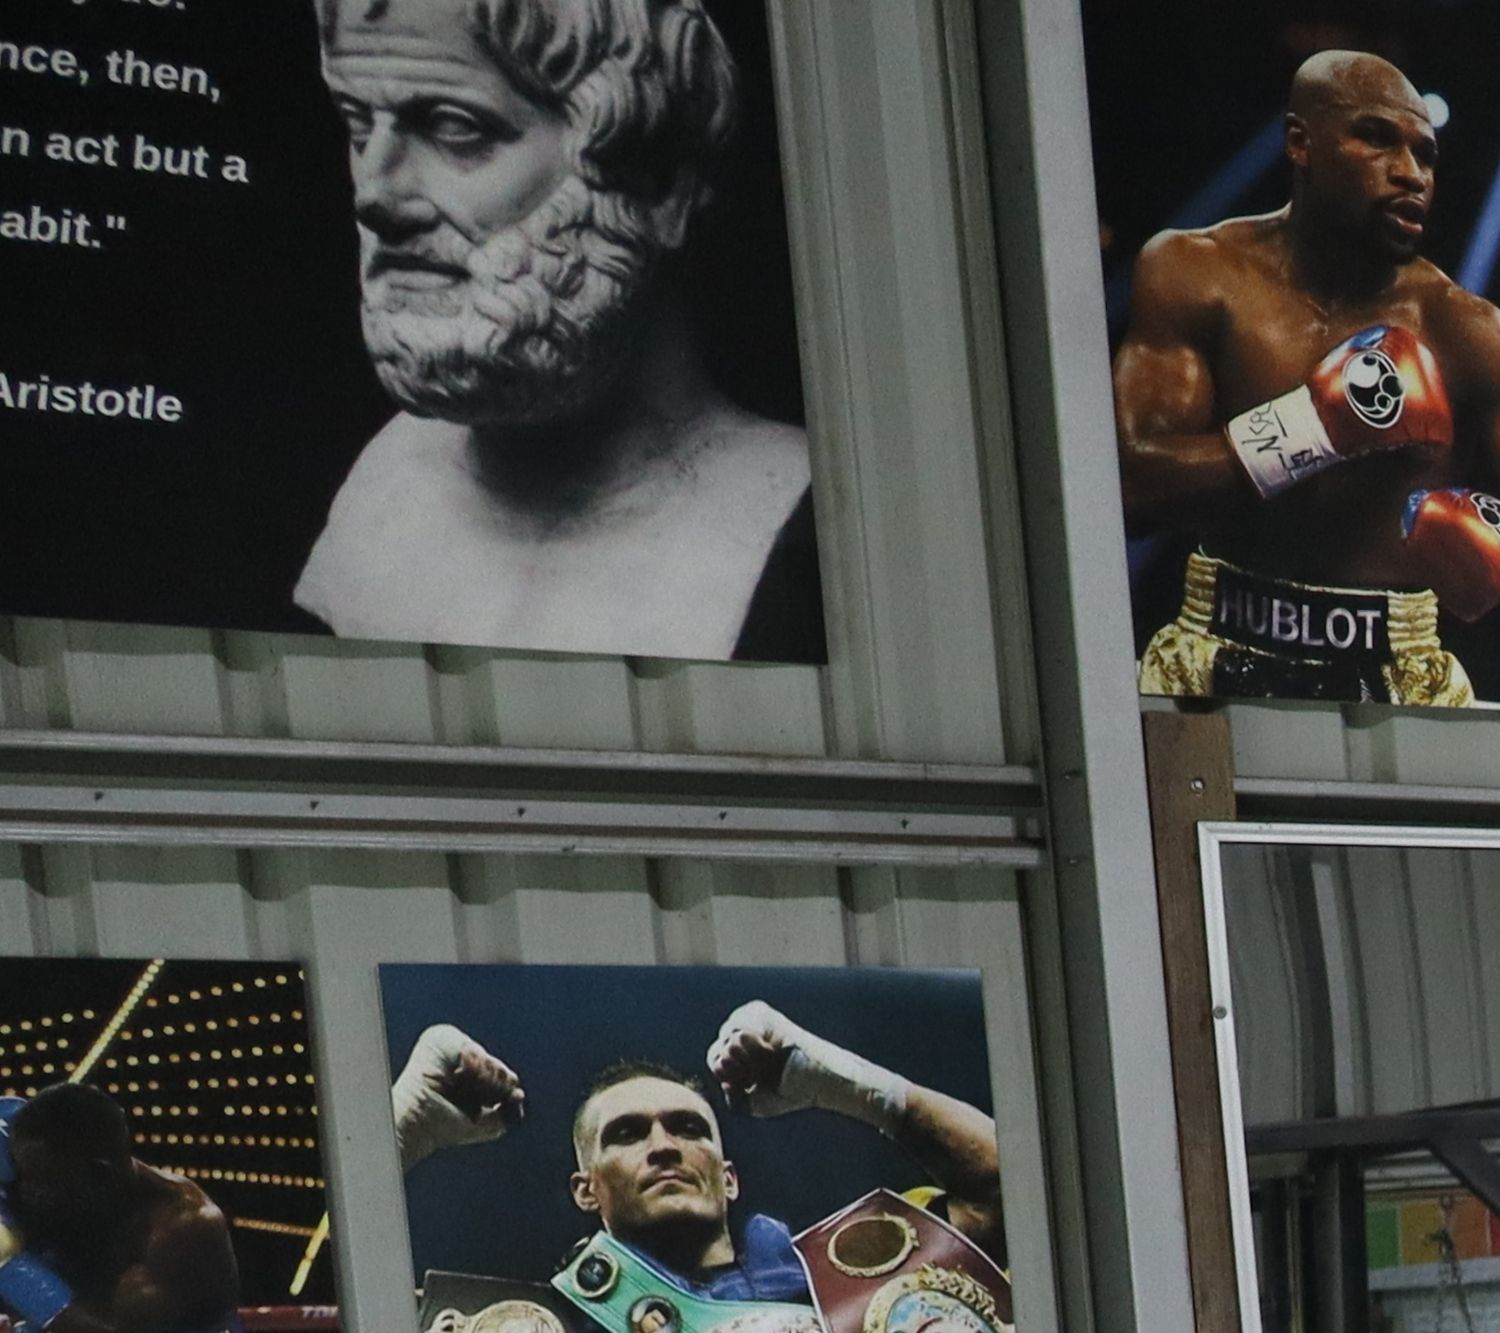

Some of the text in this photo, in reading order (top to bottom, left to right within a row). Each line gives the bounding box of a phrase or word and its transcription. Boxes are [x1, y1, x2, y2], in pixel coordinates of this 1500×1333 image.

[106, 50, 220, 102] then,
[45, 132, 120, 167] act
[133, 134, 209, 178] but
[221, 155, 249, 184] a
[1218, 588, 1383, 650] HUBLOT
